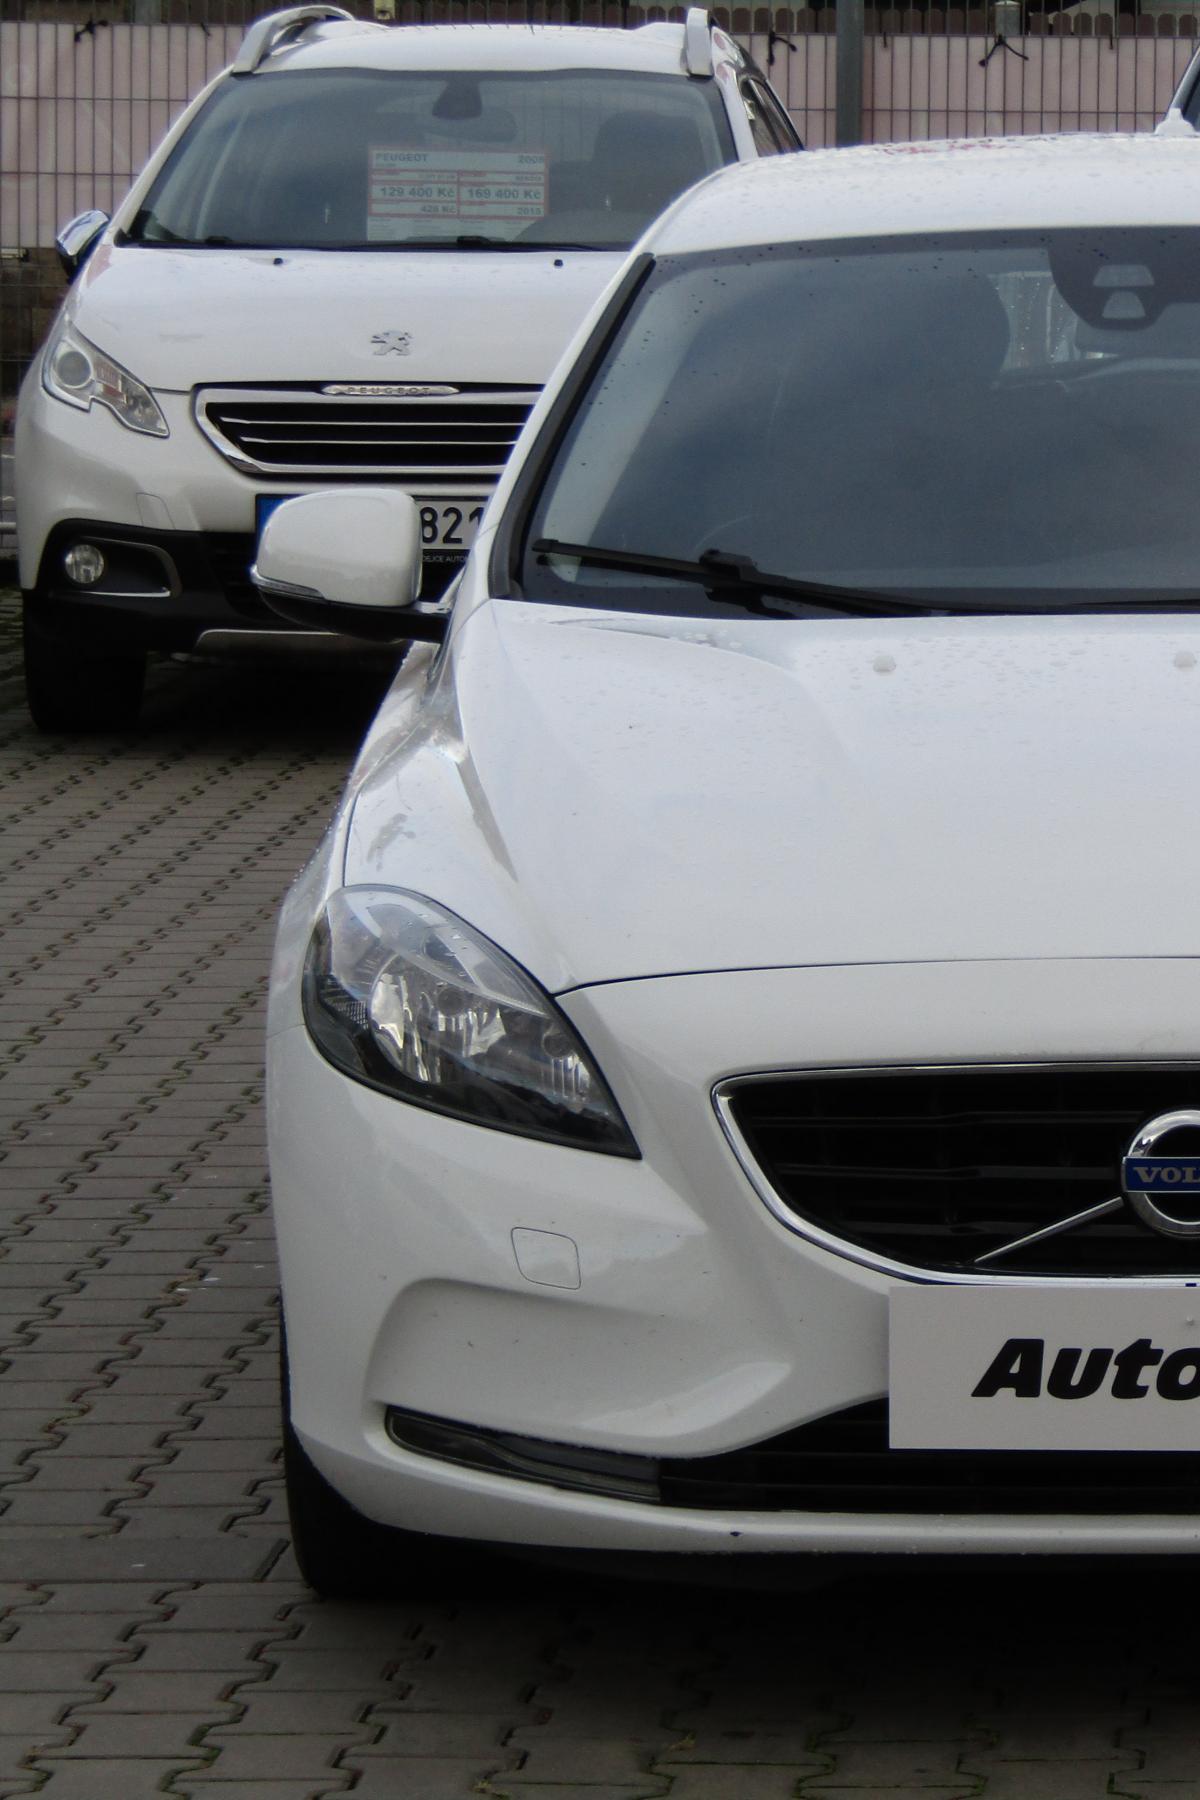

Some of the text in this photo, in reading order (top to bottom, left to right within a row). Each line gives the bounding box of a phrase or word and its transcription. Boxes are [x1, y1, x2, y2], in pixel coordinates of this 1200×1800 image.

[376, 153, 429, 162] PEUGEOT
[381, 187, 404, 197] 129
[409, 187, 433, 198] 400
[468, 188, 491, 199] 169
[495, 189, 520, 199] 400
[347, 386, 430, 394] PEUGEOT
